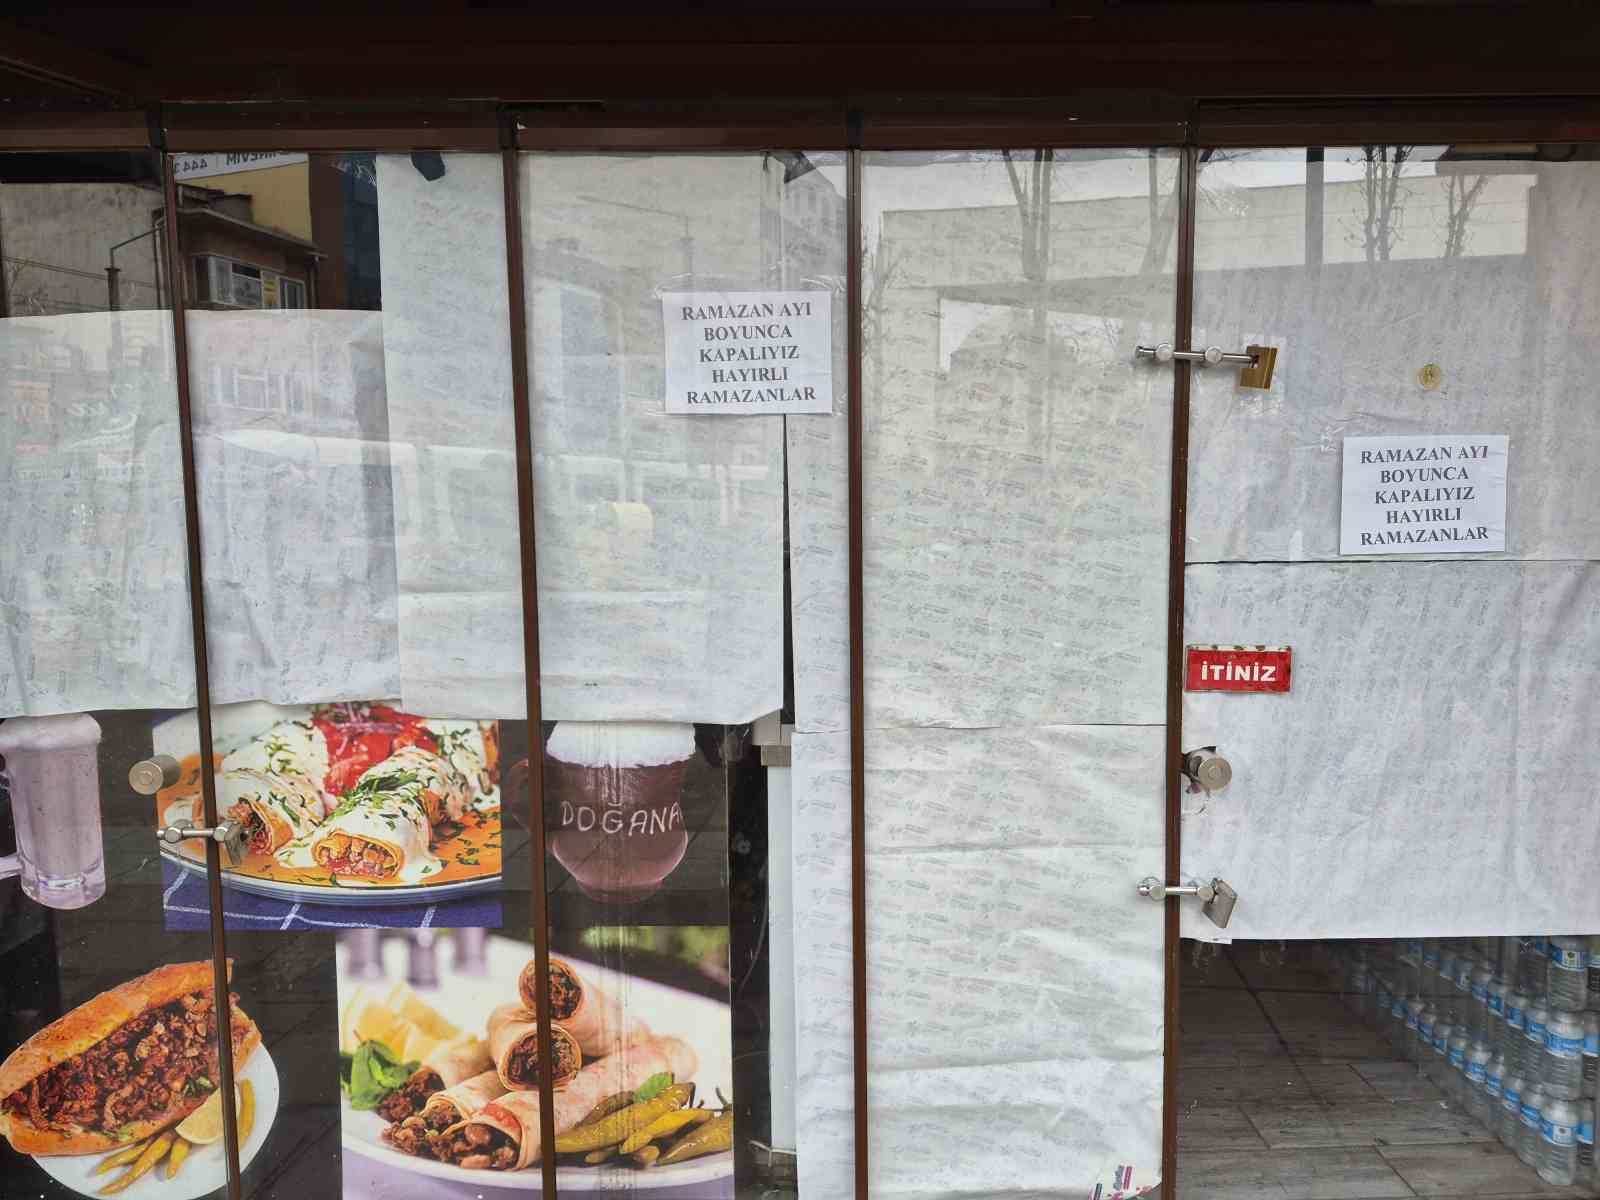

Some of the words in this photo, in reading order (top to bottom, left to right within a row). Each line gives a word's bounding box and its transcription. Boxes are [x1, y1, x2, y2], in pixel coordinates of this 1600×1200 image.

[682, 303, 774, 321] RAMAZAN
[779, 302, 812, 317] AYI
[704, 325, 792, 341] BOYUNCA
[700, 345, 800, 363] KAPALIYIZ
[712, 367, 788, 383] HAYIRLI
[687, 387, 816, 404] RAMAZANLAR
[1361, 447, 1452, 464] RAMAZAN
[1458, 445, 1488, 460] AYI
[1381, 467, 1469, 483] BOYUNCA
[1375, 486, 1475, 504] KAPALIYIZ
[1387, 507, 1463, 524] HAYIRLI
[1360, 527, 1488, 545] RAMAZANLAR
[1201, 661, 1276, 681] İTİNİZ
